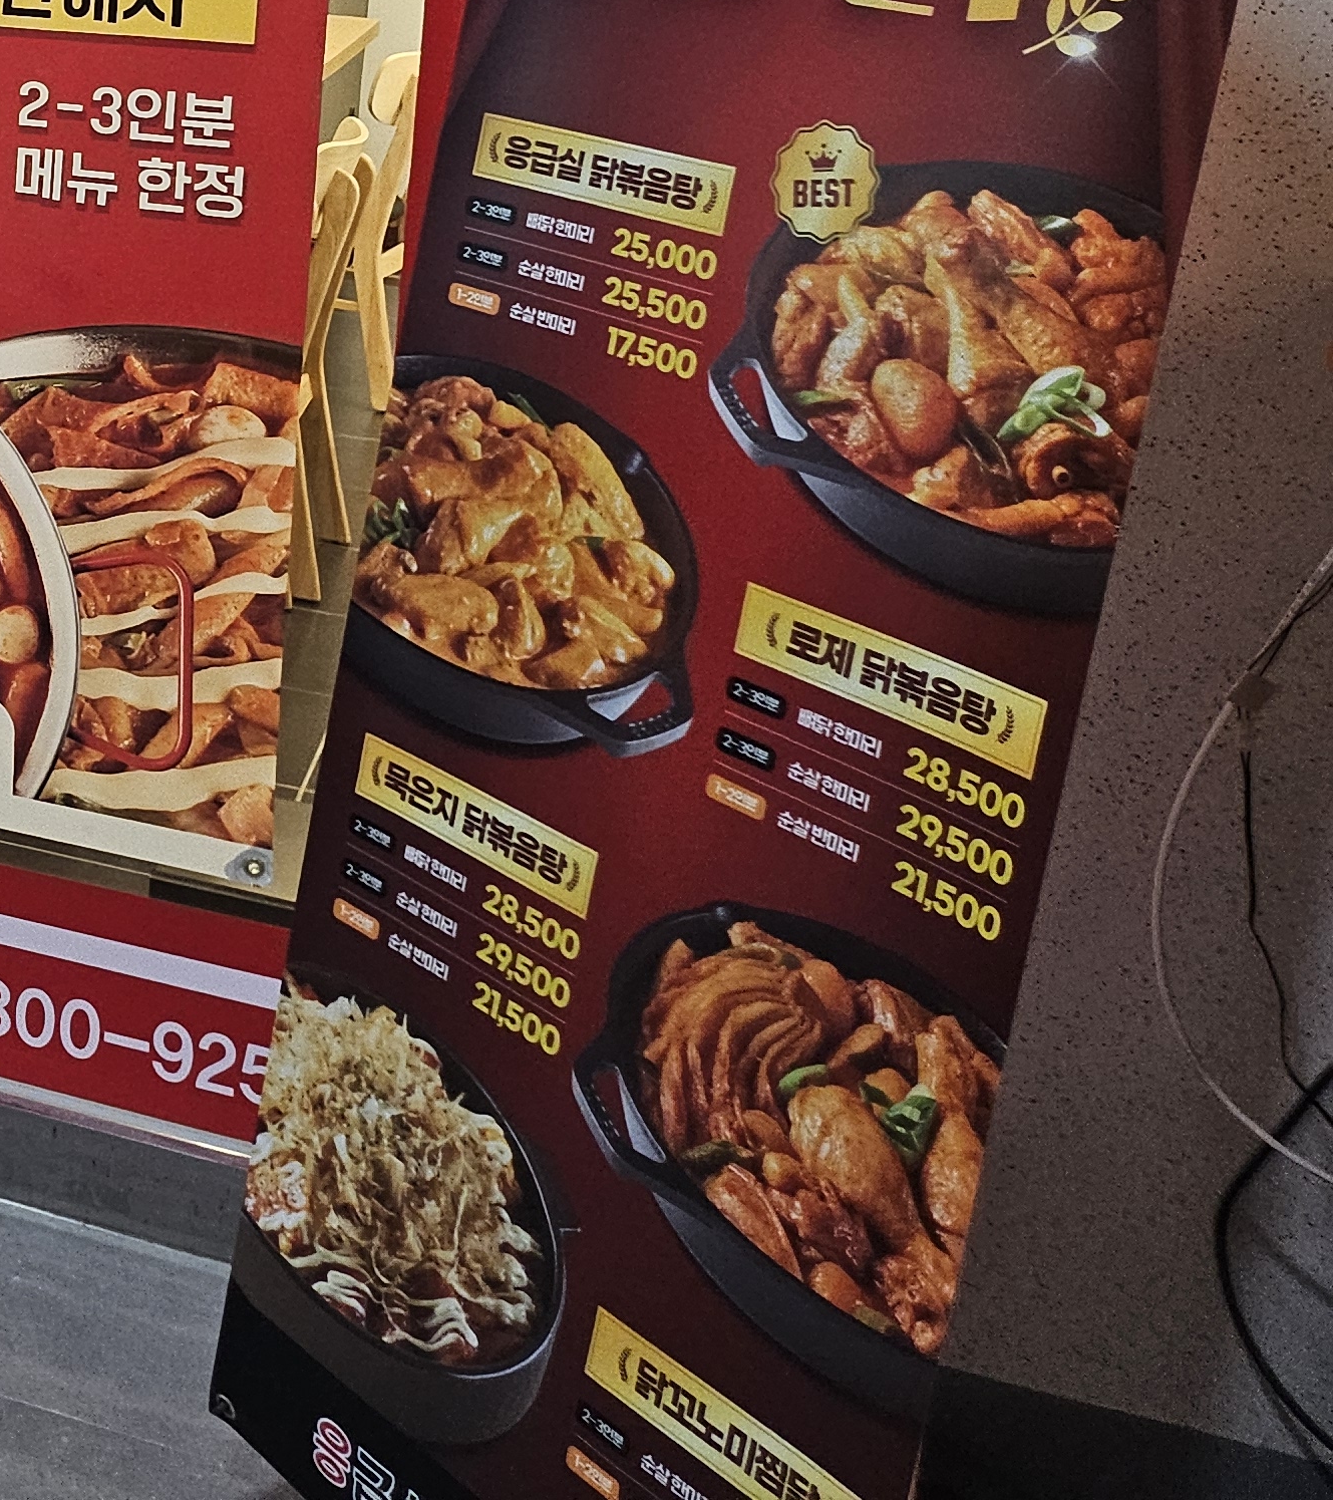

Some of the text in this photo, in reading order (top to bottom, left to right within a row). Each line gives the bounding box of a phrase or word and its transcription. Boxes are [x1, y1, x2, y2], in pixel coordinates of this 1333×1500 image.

[17, 80, 236, 150] 2-3인분
[14, 146, 245, 221] 메뉴 한정
[504, 135, 703, 211] 응급실 닭볶음탕
[792, 177, 856, 209] BEST
[610, 227, 718, 281] 25,000
[601, 275, 708, 330] 25,500
[606, 325, 698, 379] 17,500
[785, 620, 999, 736] 로제 닭볶음탕
[383, 760, 568, 886] 묵은지 닭볶음탕
[902, 747, 1026, 829] 28,500
[895, 804, 1014, 886] 29,500
[481, 883, 581, 961] 28,500
[890, 860, 1002, 942] 21,500
[475, 932, 571, 1009] 29,500
[471, 981, 561, 1057] 21,500
[312, 1417, 420, 1500] 응급
